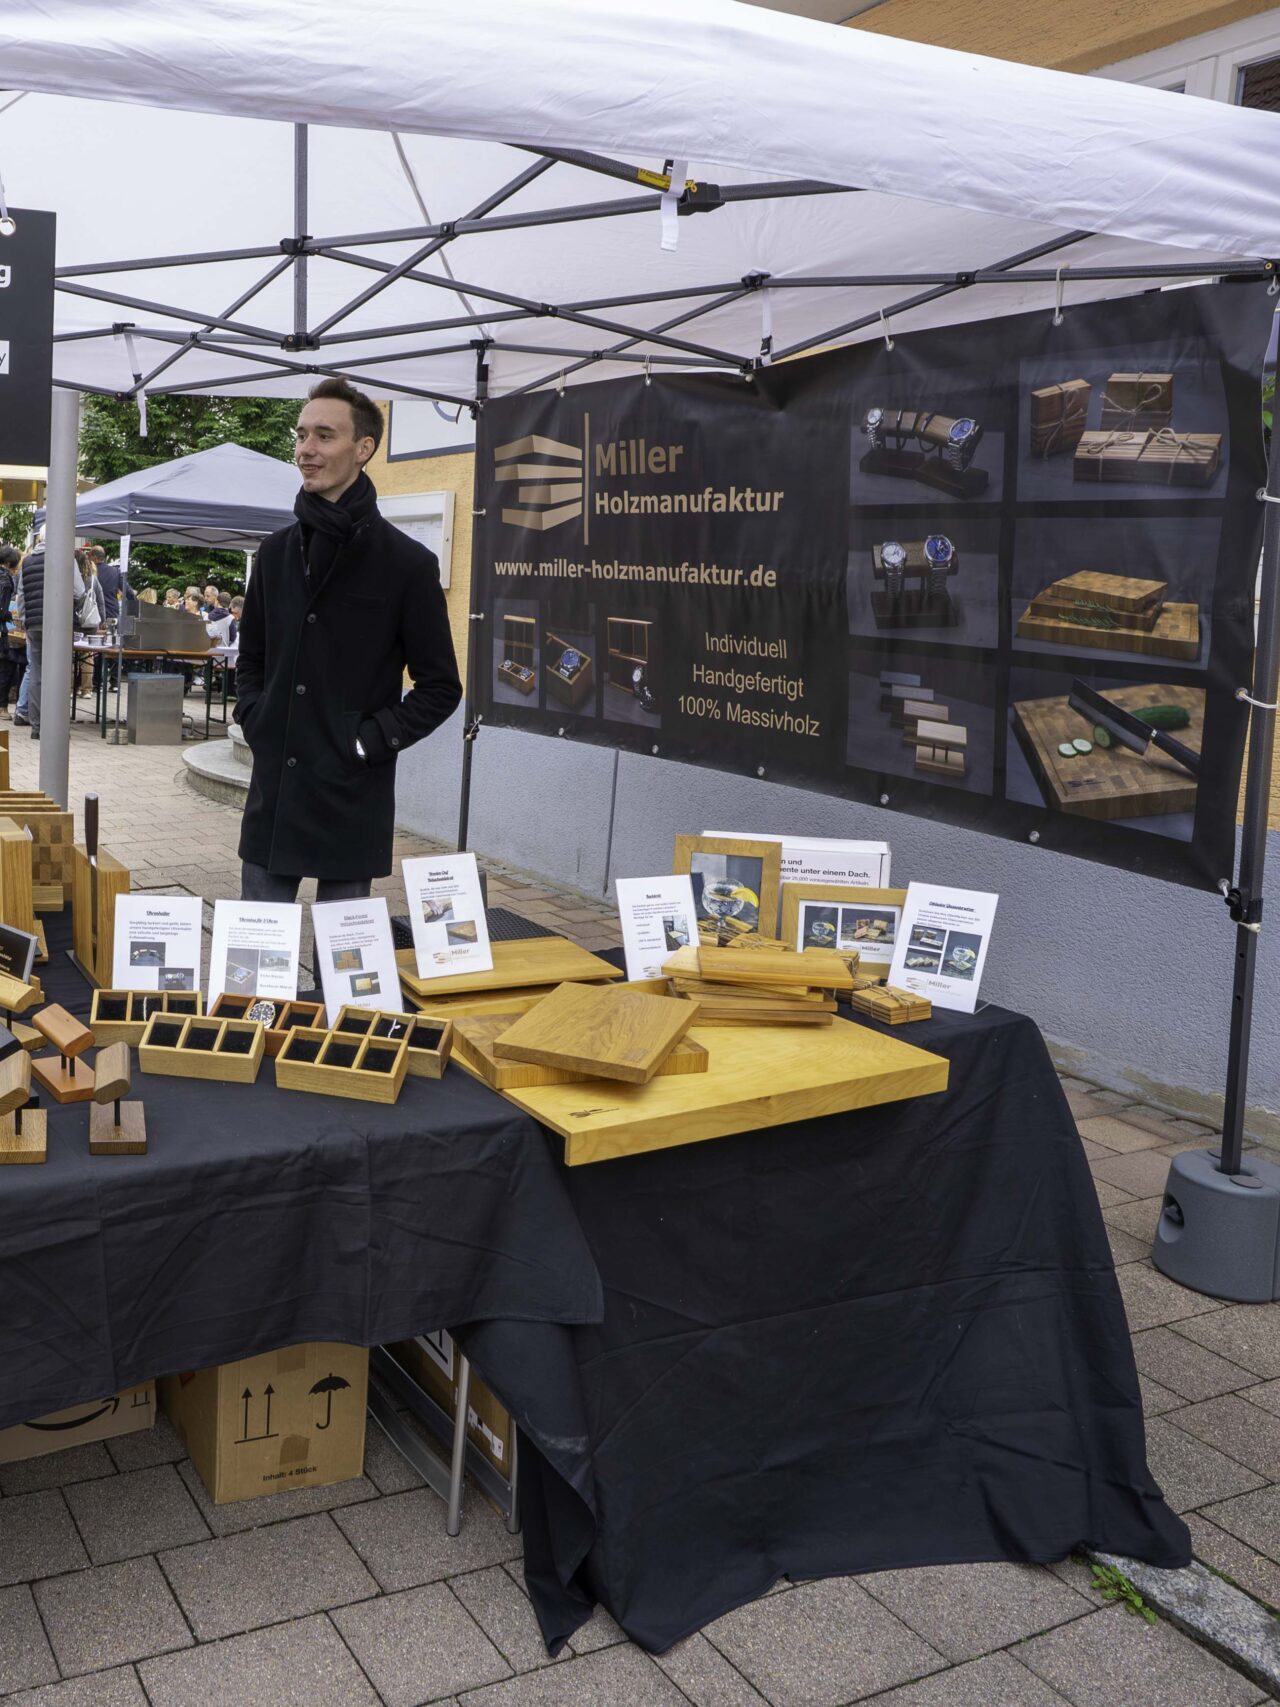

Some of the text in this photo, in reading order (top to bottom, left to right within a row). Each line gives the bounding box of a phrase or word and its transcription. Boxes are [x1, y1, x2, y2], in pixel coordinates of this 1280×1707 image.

[594, 438, 684, 477] Miller
[594, 486, 785, 515] Holzmanufaktur
[494, 558, 777, 588] www.miller-holzmanufaktur.de
[705, 631, 788, 660] Individuell
[693, 663, 804, 701] Handgefertigt
[678, 694, 820, 737] 100% Massivholz
[787, 858, 803, 866] und
[822, 869, 846, 877] einem
[848, 870, 871, 879] Dach.
[263, 1472, 286, 1481] Inhalt:
[295, 1466, 317, 1475] Stück
